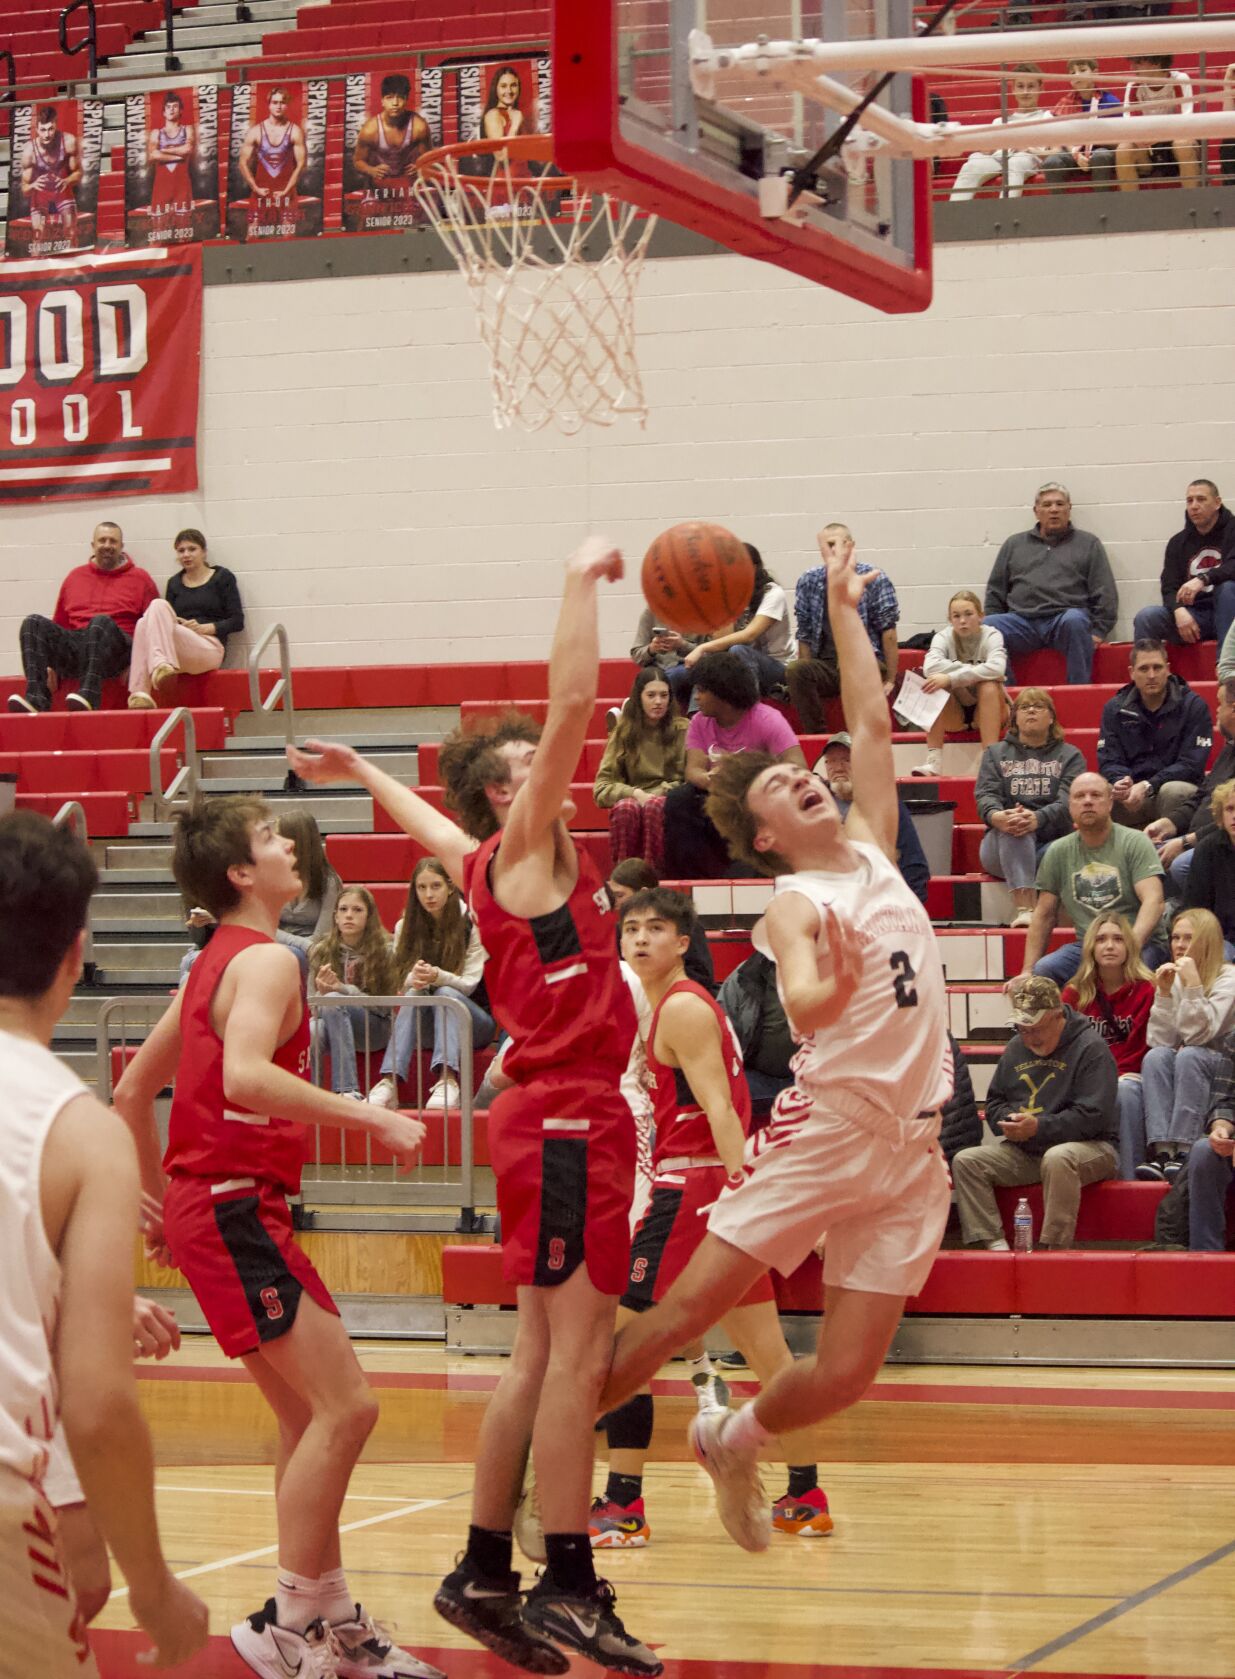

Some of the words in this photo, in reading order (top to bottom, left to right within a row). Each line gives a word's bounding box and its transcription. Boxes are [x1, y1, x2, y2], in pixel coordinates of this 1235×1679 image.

[127, 95, 146, 167] SPARTANS
[199, 84, 218, 160] SPARTANS
[307, 81, 328, 154] SPARTANS
[83, 101, 104, 172] SPARTANS
[257, 196, 290, 208] THOR
[147, 228, 173, 242] SENIOR
[174, 226, 194, 239] 2023
[248, 225, 275, 236] SENIOR
[276, 223, 296, 235] 2023
[365, 216, 392, 228] SENIOR
[393, 214, 413, 226] 2023
[27, 241, 52, 254] SENIOR
[53, 239, 71, 251] 2023
[1010, 777, 1051, 796] STATE
[889, 950, 918, 1009] 2
[547, 1237, 566, 1270] S
[631, 1257, 648, 1282] S
[260, 1287, 284, 1320] S
